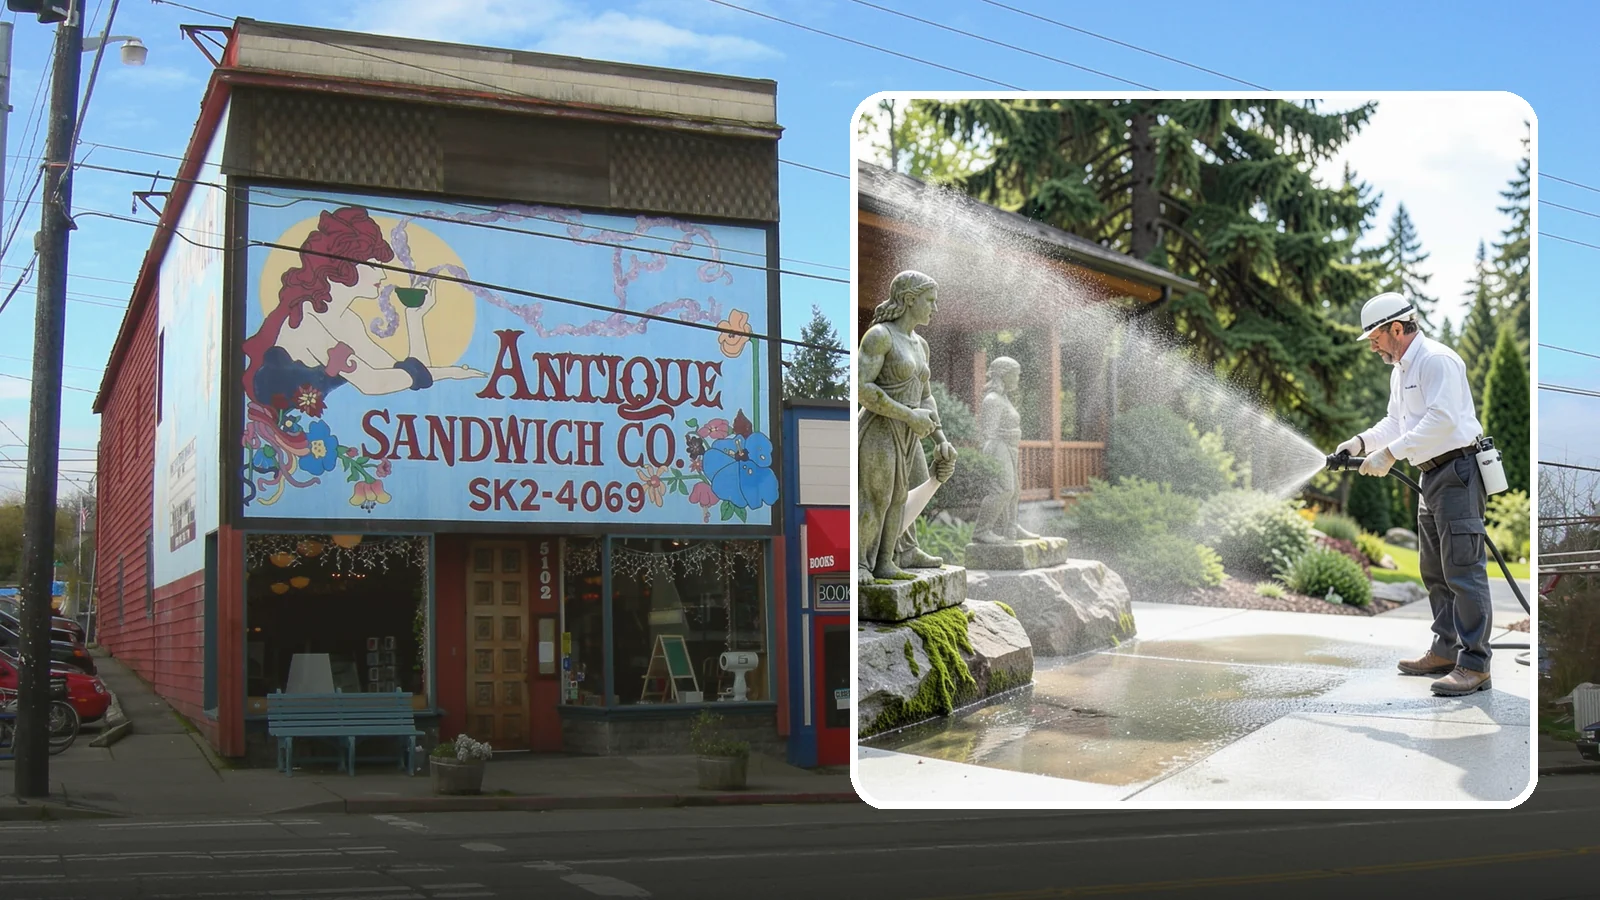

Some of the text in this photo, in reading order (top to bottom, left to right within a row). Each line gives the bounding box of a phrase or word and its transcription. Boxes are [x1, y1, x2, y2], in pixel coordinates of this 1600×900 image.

[476, 329, 723, 420] ANTIQUE
[361, 408, 685, 470] SANDWICH CO.
[468, 477, 646, 512] SK2-4069
[539, 541, 552, 600] 5102
[809, 555, 835, 569] BOOKS
